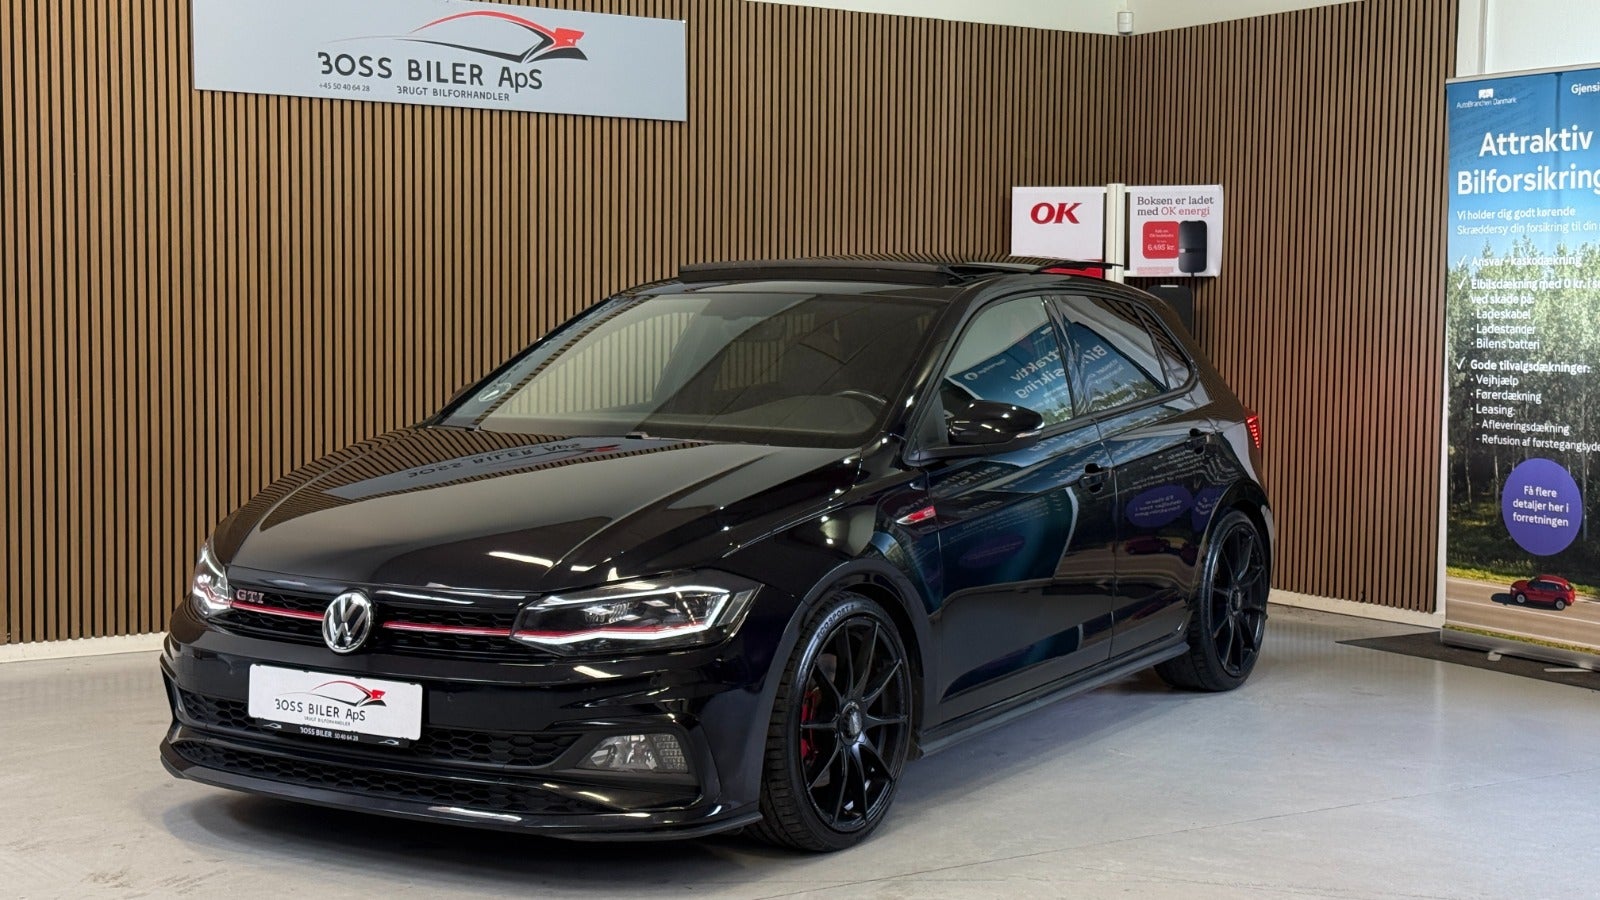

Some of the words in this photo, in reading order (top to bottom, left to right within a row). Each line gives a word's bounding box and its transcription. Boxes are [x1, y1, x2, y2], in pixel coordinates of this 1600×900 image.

[408, 59, 483, 86] BILER
[498, 66, 542, 93] ApS
[432, 88, 510, 101] BILFORHANDLER
[1479, 124, 1593, 156] Attraktiv
[1137, 196, 1172, 205] Boksen
[1189, 196, 1214, 204] ladet
[1030, 202, 1082, 224] OK
[1138, 207, 1158, 215] med
[1161, 207, 1177, 215] OK
[1179, 207, 1210, 217] energi
[1457, 210, 1466, 220] Vi
[1468, 210, 1495, 219] holder
[1498, 209, 1512, 220] dig
[1514, 208, 1535, 220] godt
[1537, 206, 1576, 217] kørende
[1457, 224, 1508, 235] Skræddersy
[1511, 224, 1524, 232] din
[1526, 222, 1568, 234] forsikring
[1571, 221, 1580, 231] til
[1583, 220, 1597, 230] din
[1540, 278, 1561, 288] med
[1564, 278, 1570, 288] 0
[1471, 295, 1488, 304] ved
[1490, 295, 1519, 304] skade
[1477, 309, 1531, 319] Ladeskabel
[1477, 324, 1536, 334] Ladestander
[1477, 338, 1506, 348] Bilens
[1509, 340, 1539, 349] batteri
[1470, 360, 1497, 370] Gode
[1499, 360, 1590, 375] tilvalgsdækninger:
[1476, 375, 1519, 387] Vejhjælp
[1476, 389, 1542, 404] Førerdækning
[1476, 404, 1515, 418] Leasing:
[1482, 419, 1569, 436] Afleveringsdækning
[1482, 434, 1520, 446] Refusion
[1522, 437, 1531, 446] af
[1524, 486, 1534, 495] Få
[1536, 487, 1557, 497] flere
[1513, 499, 1546, 512] detaljer
[1549, 502, 1564, 512] her
[1513, 512, 1568, 528] forretningen
[236, 589, 264, 604] GTI
[308, 704, 340, 718] BILER
[346, 708, 366, 722] ApS
[316, 729, 332, 738] BILER
